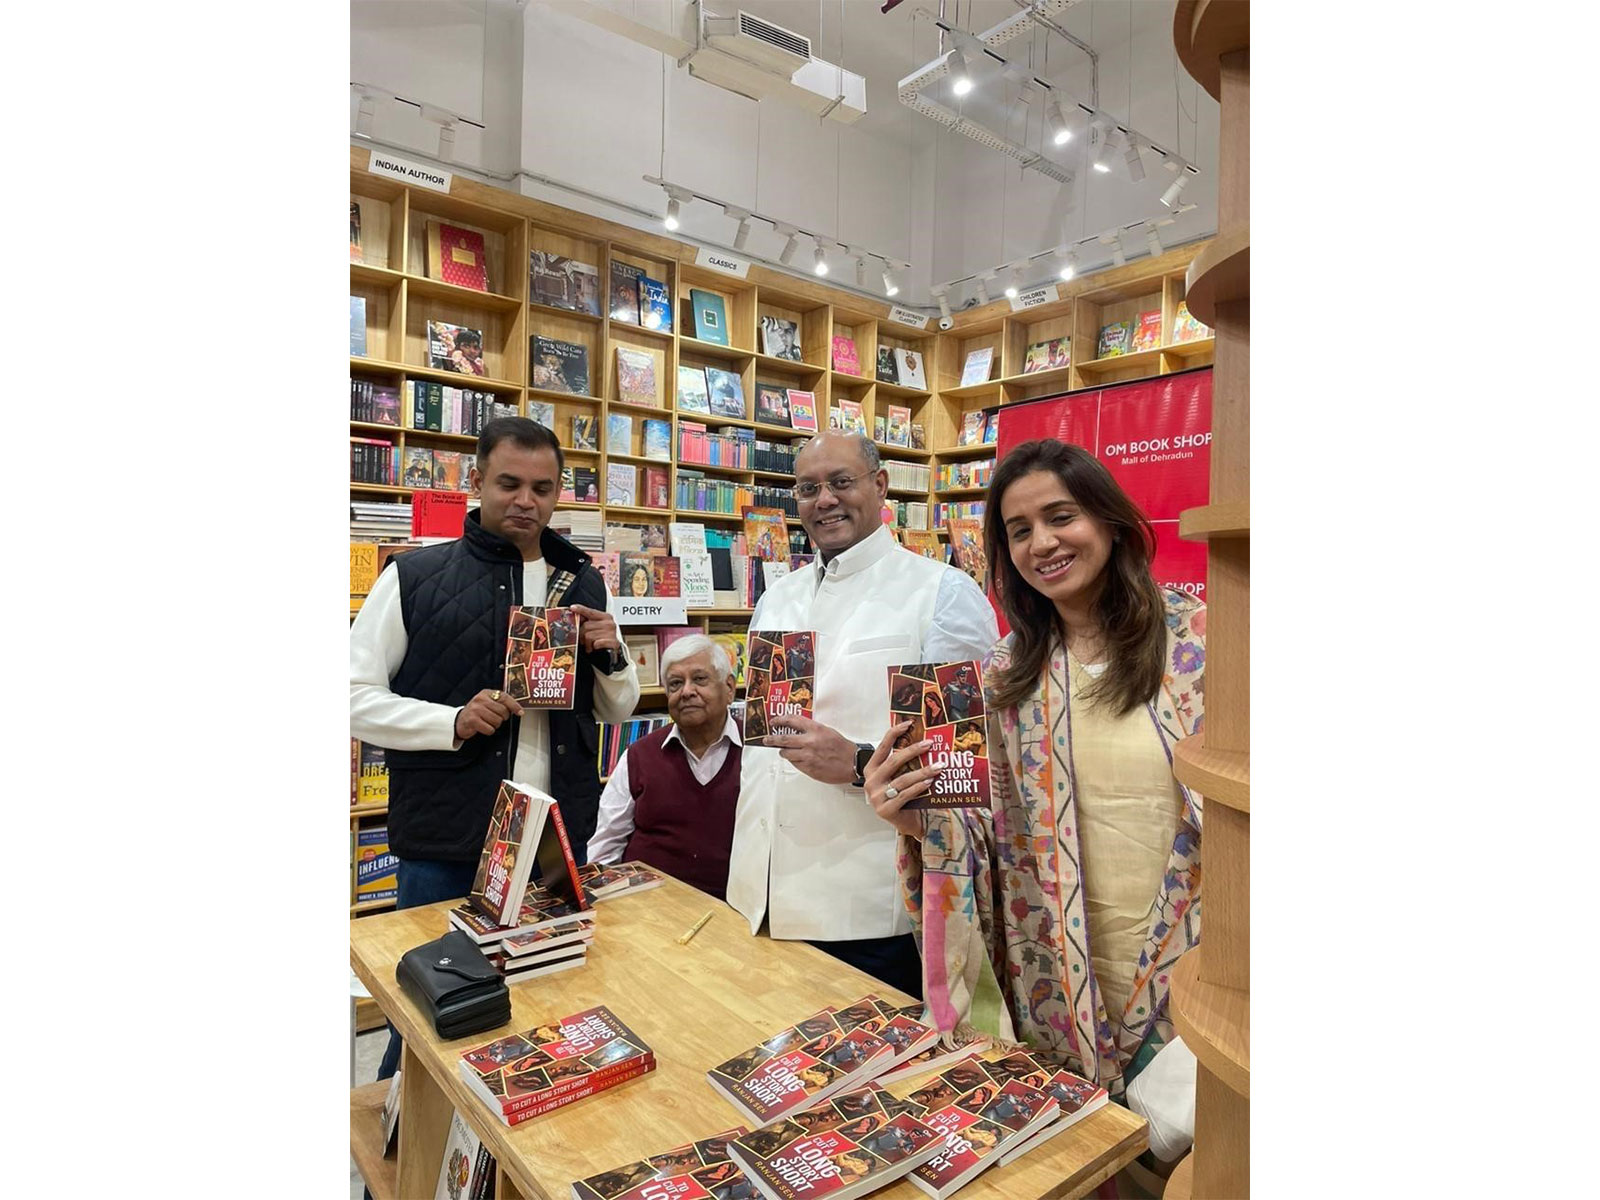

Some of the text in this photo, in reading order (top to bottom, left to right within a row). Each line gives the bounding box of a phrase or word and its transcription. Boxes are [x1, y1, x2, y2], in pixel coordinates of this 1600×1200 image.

[375, 159, 445, 185] INDIAN AUTHOR
[708, 257, 737, 270] CLASSICS
[1020, 289, 1047, 302] CHILDREN
[1024, 297, 1046, 307] FICTION
[1105, 432, 1213, 457] OM BOOK SHOP
[1121, 451, 1194, 466] Mall of Dehradun
[351, 554, 371, 566] IN
[622, 606, 663, 615] POETRY
[531, 667, 565, 680] LONG
[538, 680, 563, 688] STORY
[533, 688, 567, 698] SHORT
[769, 702, 803, 716] LONG
[932, 734, 943, 743] TO
[944, 743, 950, 751] A
[928, 750, 975, 768] LONG
[363, 765, 390, 777] DREA
[940, 768, 973, 779] STORY
[363, 785, 387, 797] Fre
[935, 779, 980, 794] SHORT
[359, 855, 400, 876] INFLUEN
[489, 860, 508, 885] LONG
[485, 885, 503, 907] SHORT
[575, 1022, 601, 1040] STORY
[583, 1015, 616, 1040] SHORT
[559, 1024, 596, 1052] LONG
[780, 1057, 794, 1067] CUT
[791, 1055, 801, 1064] TO
[764, 1061, 806, 1092] LONG
[512, 1103, 520, 1111] TO
[520, 1099, 532, 1109] CUT
[537, 1088, 553, 1102] LONG
[553, 1083, 571, 1097] STORY
[571, 1077, 589, 1090] SHORT
[595, 1066, 621, 1079] RANJAN
[622, 1061, 635, 1071] SEN
[744, 1078, 783, 1107] SHORT
[760, 1075, 790, 1097] STORY
[517, 1113, 525, 1121] TO
[525, 1109, 537, 1120] CUT
[543, 1099, 559, 1113] LONG
[559, 1093, 576, 1107] STORY
[576, 1087, 594, 1101] SHORT
[599, 1076, 626, 1089] RANJAN
[626, 1070, 638, 1081] SEN
[732, 1083, 768, 1115] RANJAN SEN
[935, 1113, 953, 1126] CUT
[949, 1112, 961, 1122] TO
[812, 1137, 835, 1156] CUT A
[827, 1137, 838, 1147] TO
[793, 1141, 842, 1179] LONG
[770, 1157, 815, 1192] SHORT
[789, 1155, 823, 1182] STORY
[920, 1167, 939, 1180] SEN
[676, 1181, 690, 1192] TO
[754, 1161, 795, 1200] RANJAN SEN
[662, 1180, 680, 1198] CUT
